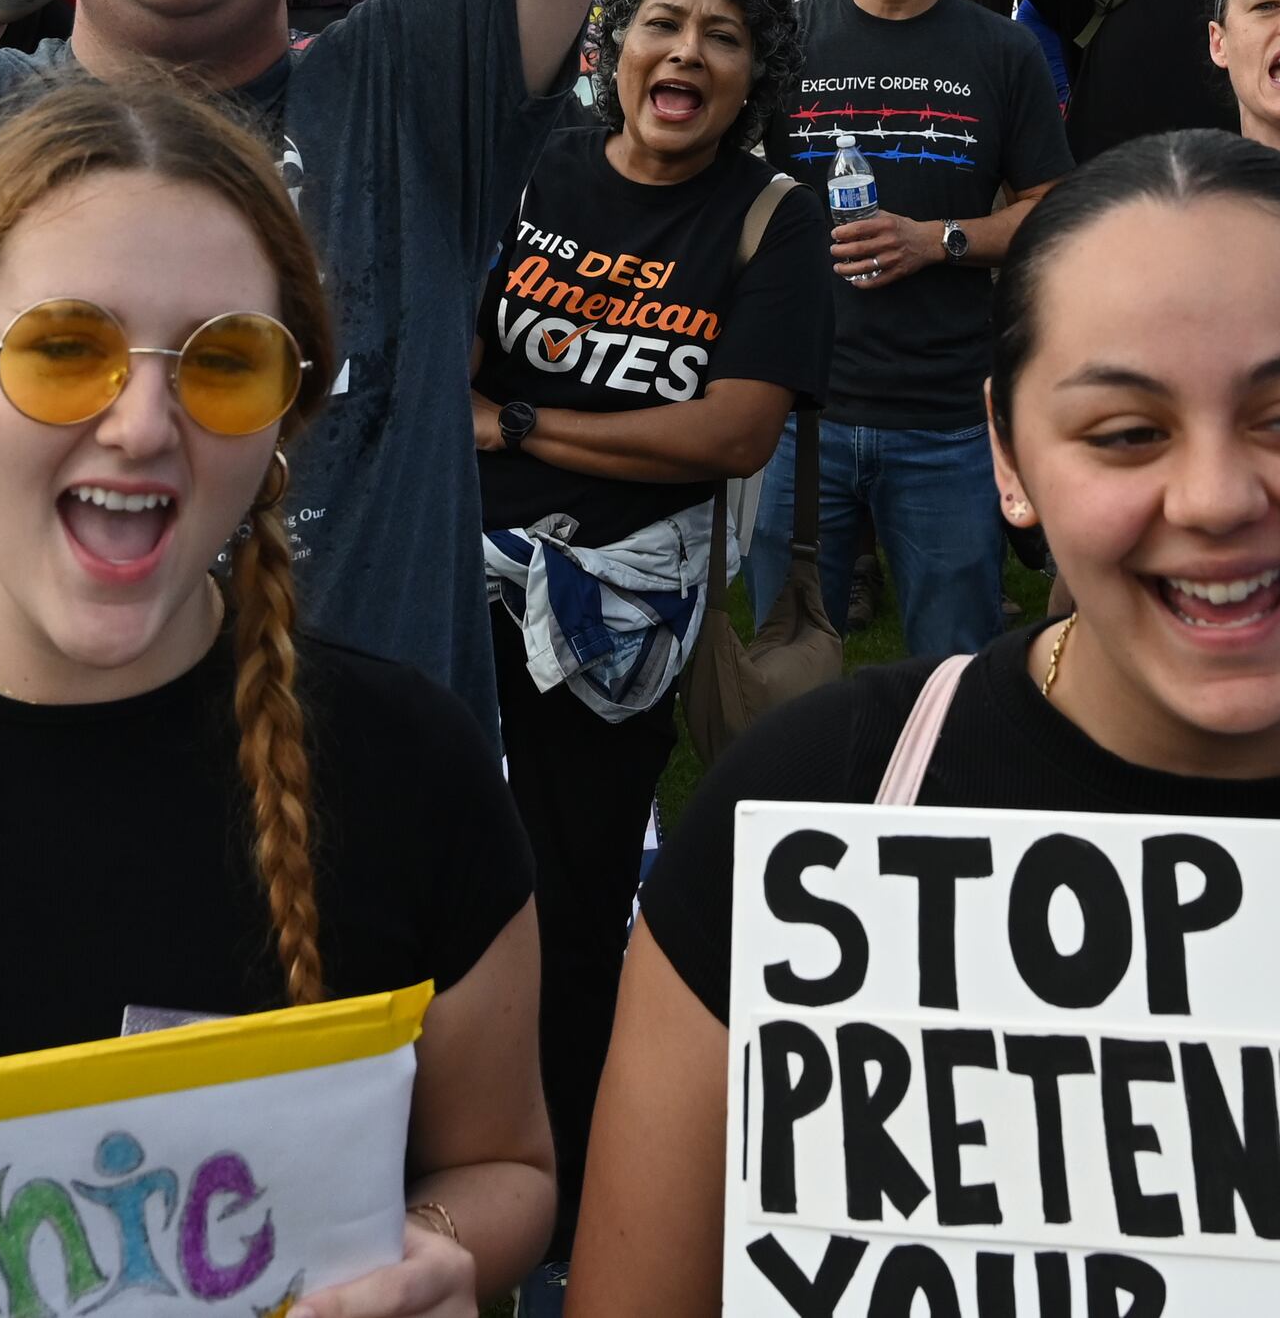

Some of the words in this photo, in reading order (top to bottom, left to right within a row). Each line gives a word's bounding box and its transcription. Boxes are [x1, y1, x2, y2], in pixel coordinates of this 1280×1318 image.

[801, 76, 876, 93] EXECUTIVE
[880, 76, 929, 91] ORDER
[934, 79, 971, 97] 9066
[517, 220, 579, 261] THIS
[577, 249, 676, 290] DESI
[506, 255, 720, 340] American
[496, 298, 709, 403] VOTES
[300, 508, 326, 522] Our
[763, 829, 1245, 1016] STOP
